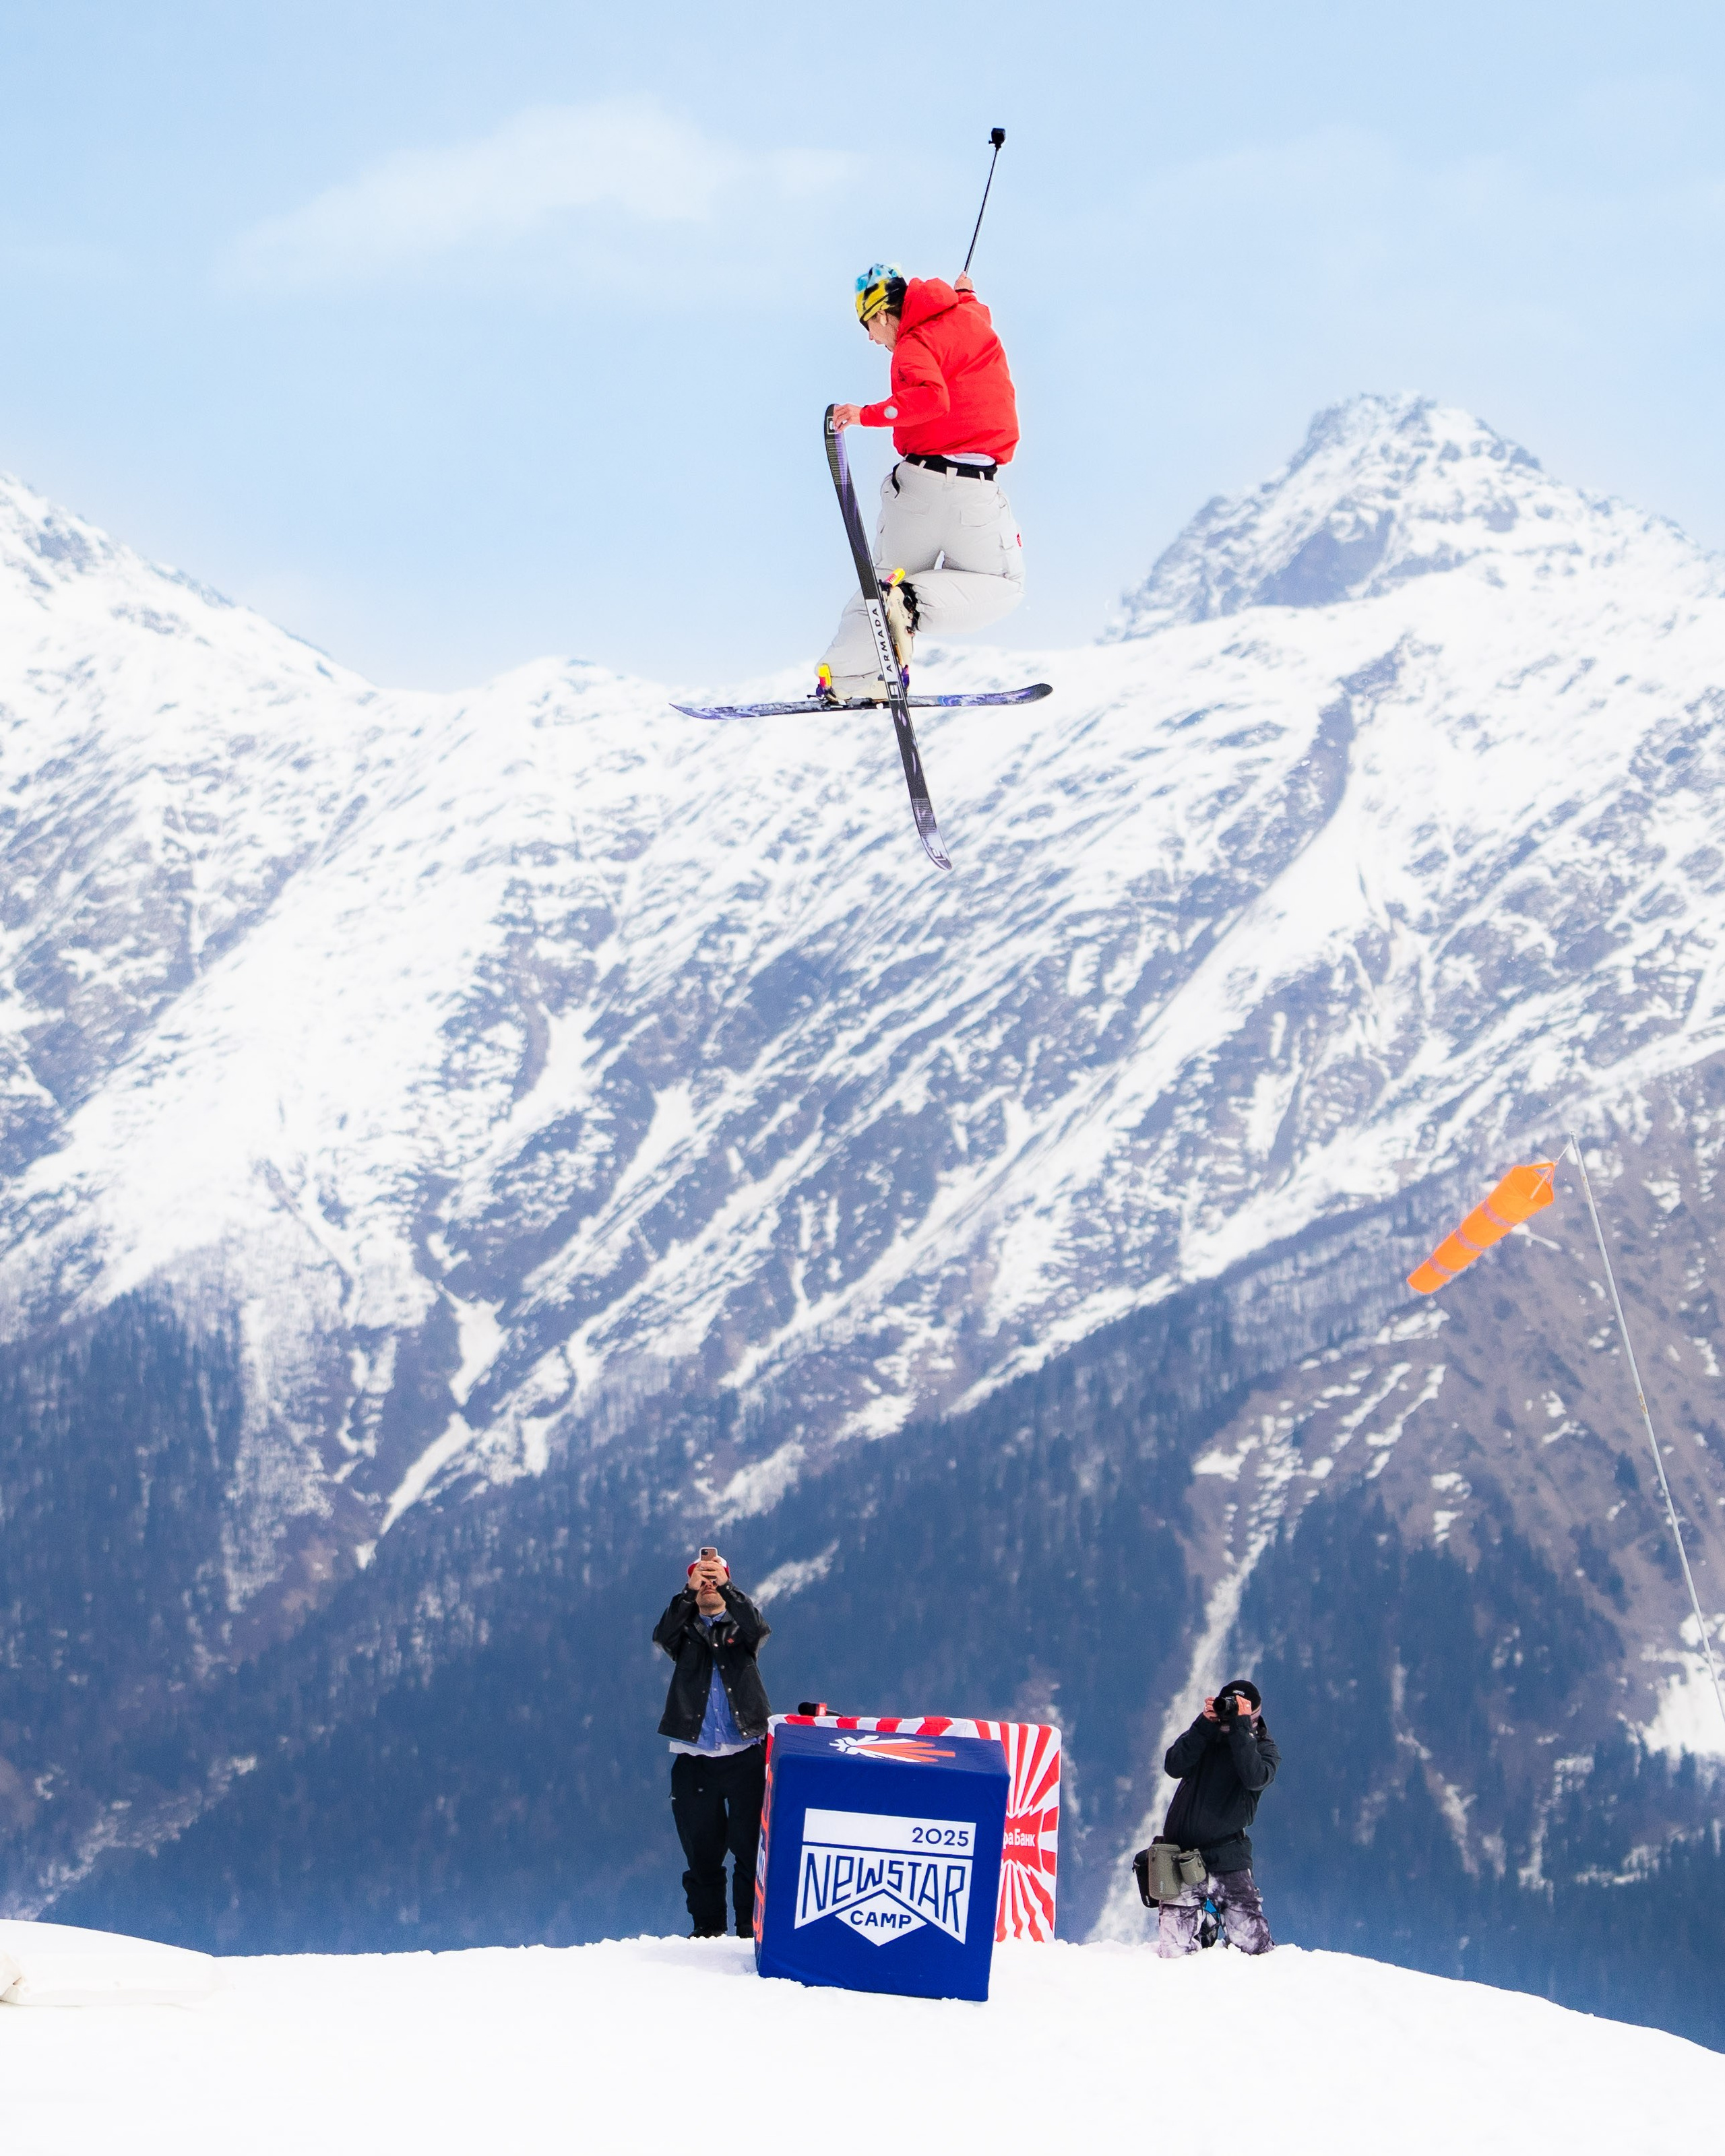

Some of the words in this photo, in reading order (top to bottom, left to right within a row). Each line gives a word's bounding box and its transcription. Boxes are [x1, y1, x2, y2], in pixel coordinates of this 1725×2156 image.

[872, 608, 893, 672] ARMADA
[912, 1827, 969, 1847] 2025
[850, 1910, 912, 1929] CAMP
